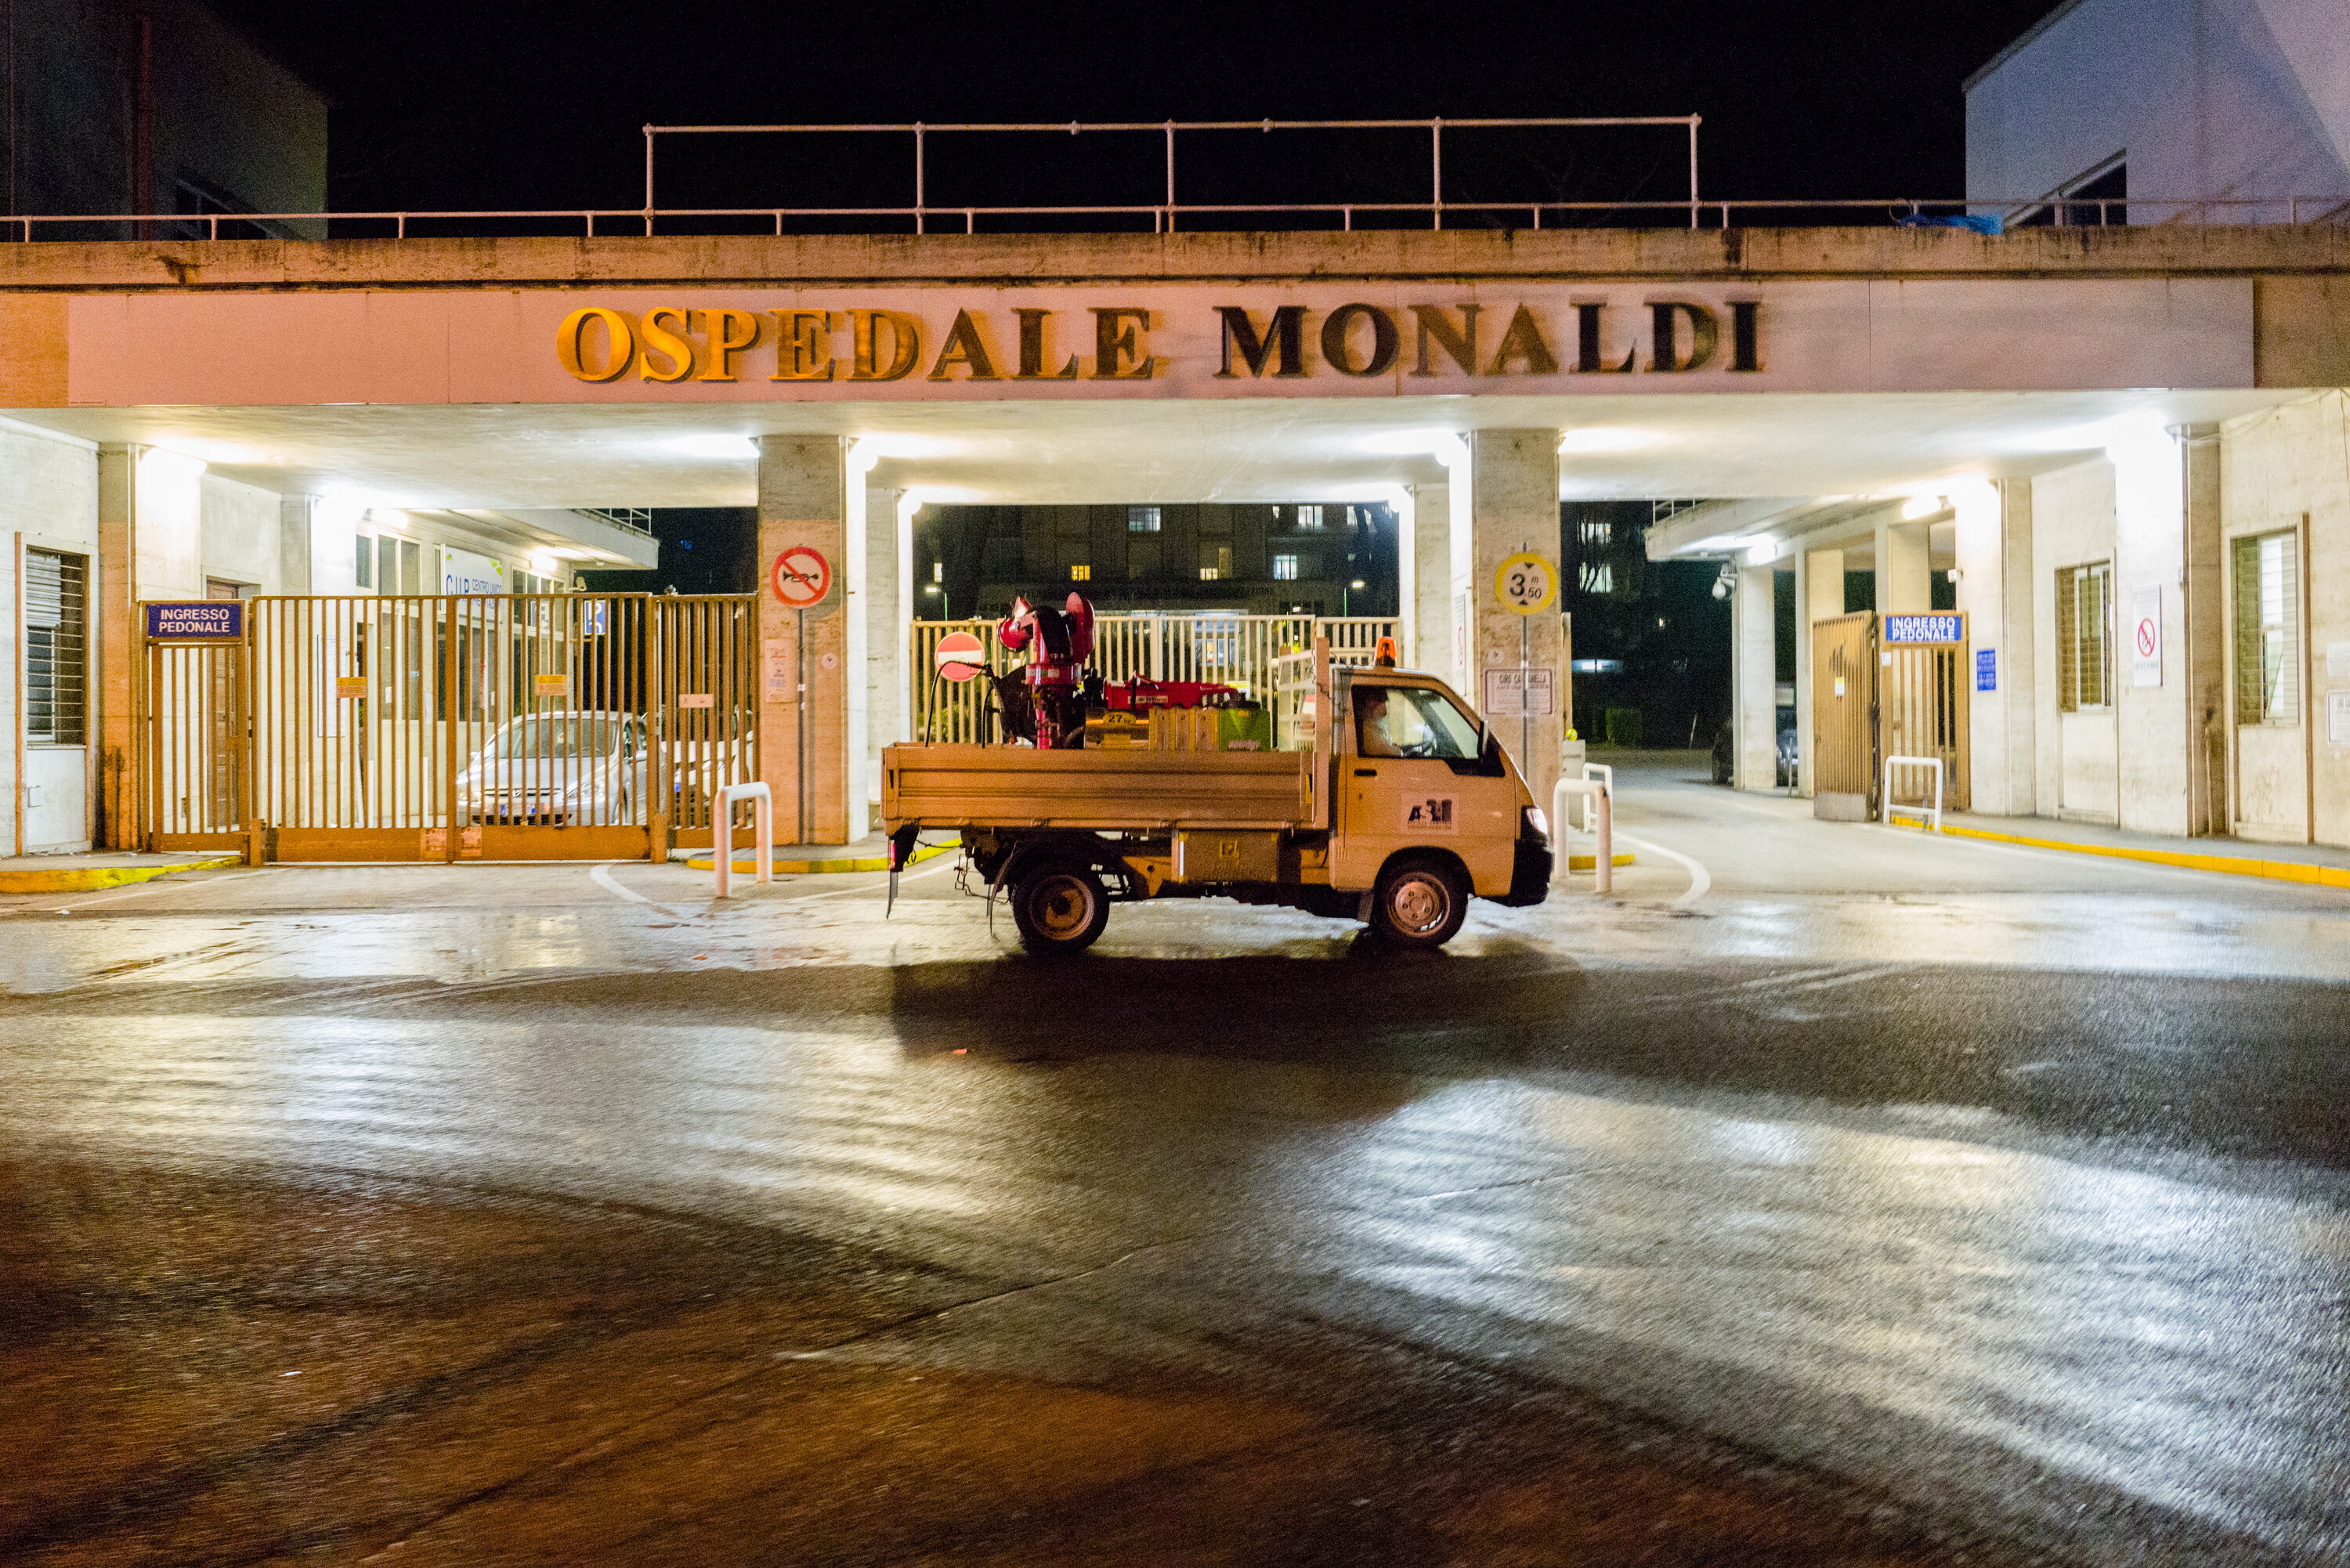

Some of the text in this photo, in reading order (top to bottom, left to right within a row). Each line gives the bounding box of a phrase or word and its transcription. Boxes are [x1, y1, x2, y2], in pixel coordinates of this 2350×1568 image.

[556, 301, 1763, 383] OSPEDALE MONALDI
[160, 609, 230, 620] INGRESSO
[158, 621, 231, 633] PEDONALE
[1892, 616, 1955, 629] INGRESSO
[1892, 629, 1955, 641] PEDONALE
[1108, 714, 1123, 723] 27
